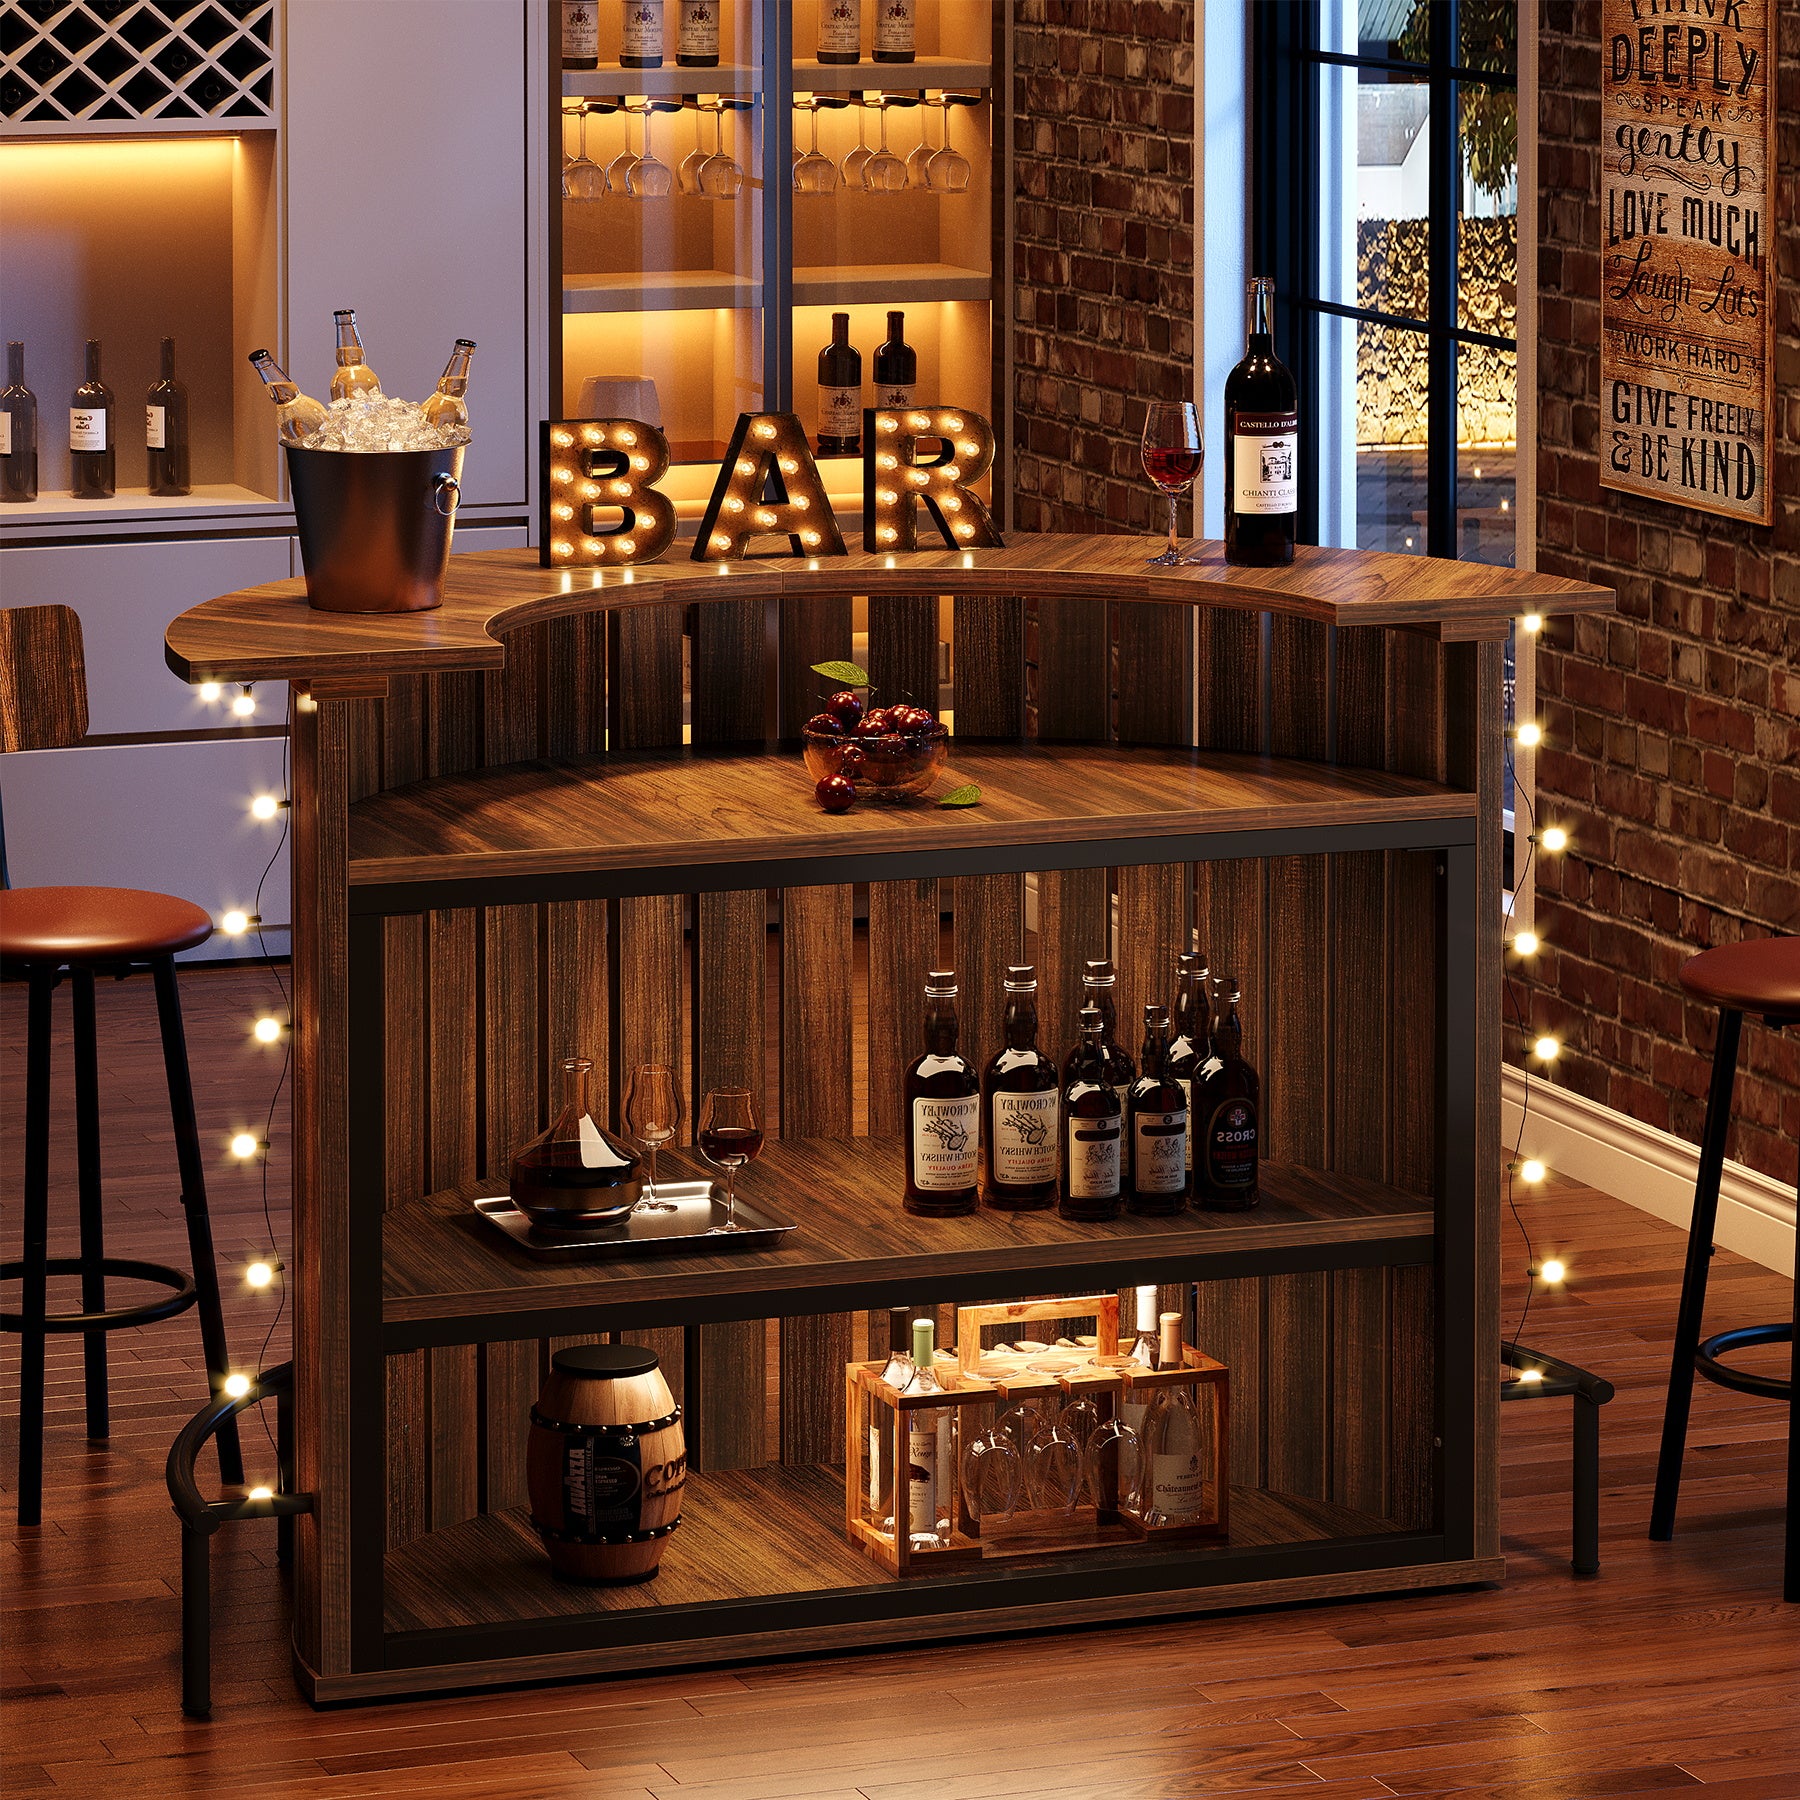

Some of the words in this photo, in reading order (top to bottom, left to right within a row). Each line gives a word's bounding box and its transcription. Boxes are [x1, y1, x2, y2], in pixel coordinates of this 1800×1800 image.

[1611, 25, 1760, 99] DEEPLY
[1615, 123, 1756, 197] gently
[1608, 189, 1669, 248] LOVE
[1682, 196, 1759, 271] MUCH
[1606, 240, 1692, 323] Laugh
[1698, 266, 1760, 325] Lots
[1623, 331, 1680, 363] WORK
[1687, 343, 1741, 374] HARD
[1239, 421, 1279, 429] CASTELLO
[1612, 380, 1678, 429] GIVE
[1687, 396, 1755, 437] FREELY
[539, 406, 1006, 569] BAR
[1242, 489, 1276, 497] CHIANTI
[1610, 430, 1633, 474] &
[1641, 432, 1670, 483] BE
[1681, 437, 1756, 502] KIND
[564, 1449, 586, 1516] LAVAZZA
